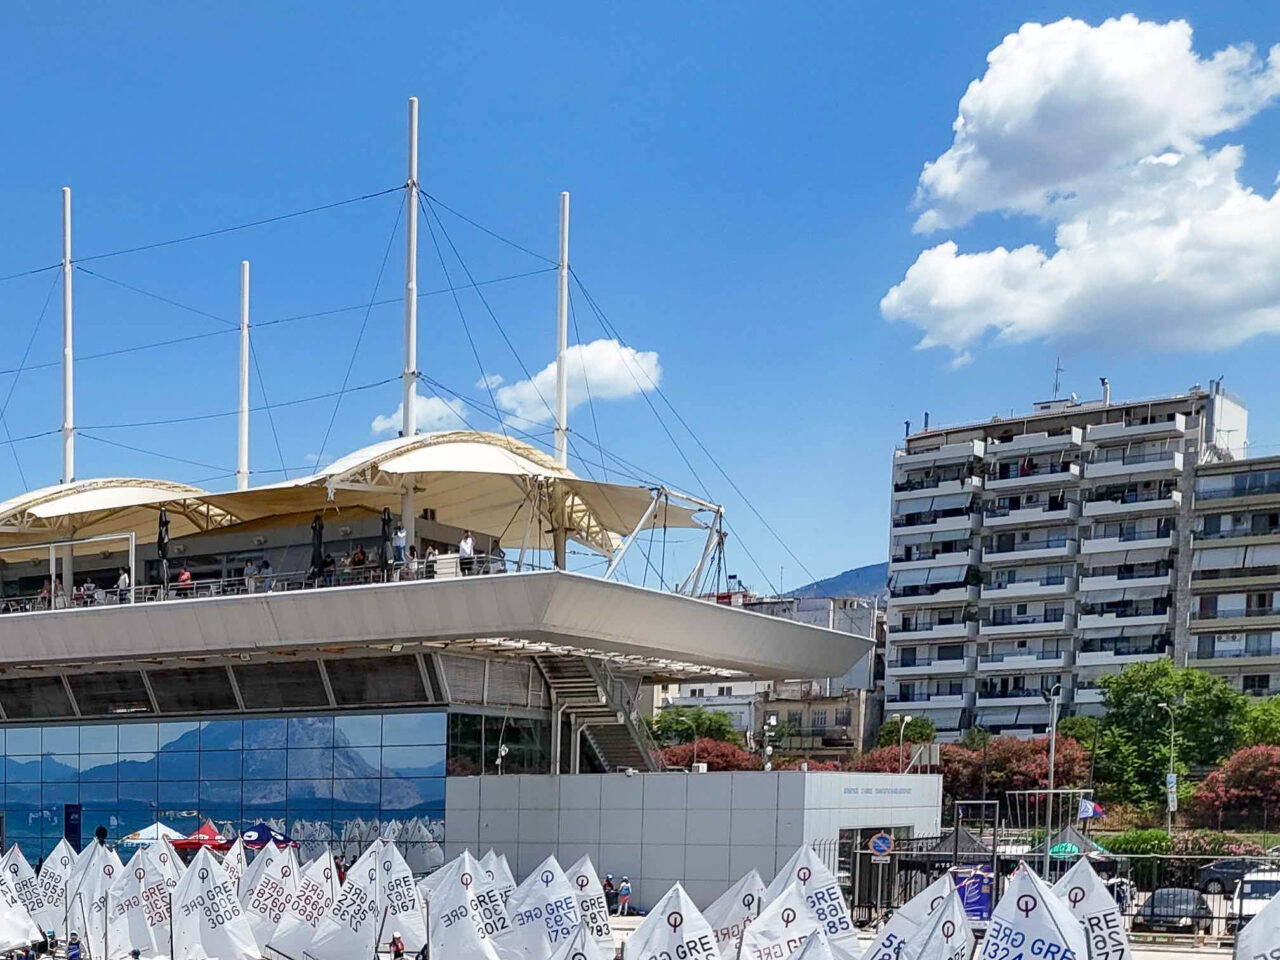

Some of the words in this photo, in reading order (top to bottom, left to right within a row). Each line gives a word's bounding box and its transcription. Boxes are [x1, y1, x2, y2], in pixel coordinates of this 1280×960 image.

[14, 877, 37, 893] GRE
[39, 879, 65, 898] 3053
[142, 882, 166, 901] GRE
[206, 881, 231, 900] GRE
[387, 875, 412, 892] GRE
[257, 888, 286, 913] 8760
[296, 890, 324, 917] 2660
[337, 893, 369, 921] 2735
[389, 899, 416, 915] 3167
[470, 889, 499, 911] GRE
[545, 896, 575, 916] GRE
[581, 896, 605, 912] GRE
[806, 886, 840, 908] GRE
[208, 905, 240, 929] 3006
[477, 917, 509, 939] 3012
[824, 916, 850, 938] 85
[1087, 911, 1120, 933] RE
[589, 923, 611, 936] 783
[676, 935, 713, 960] GRE
[882, 933, 906, 955] 58
